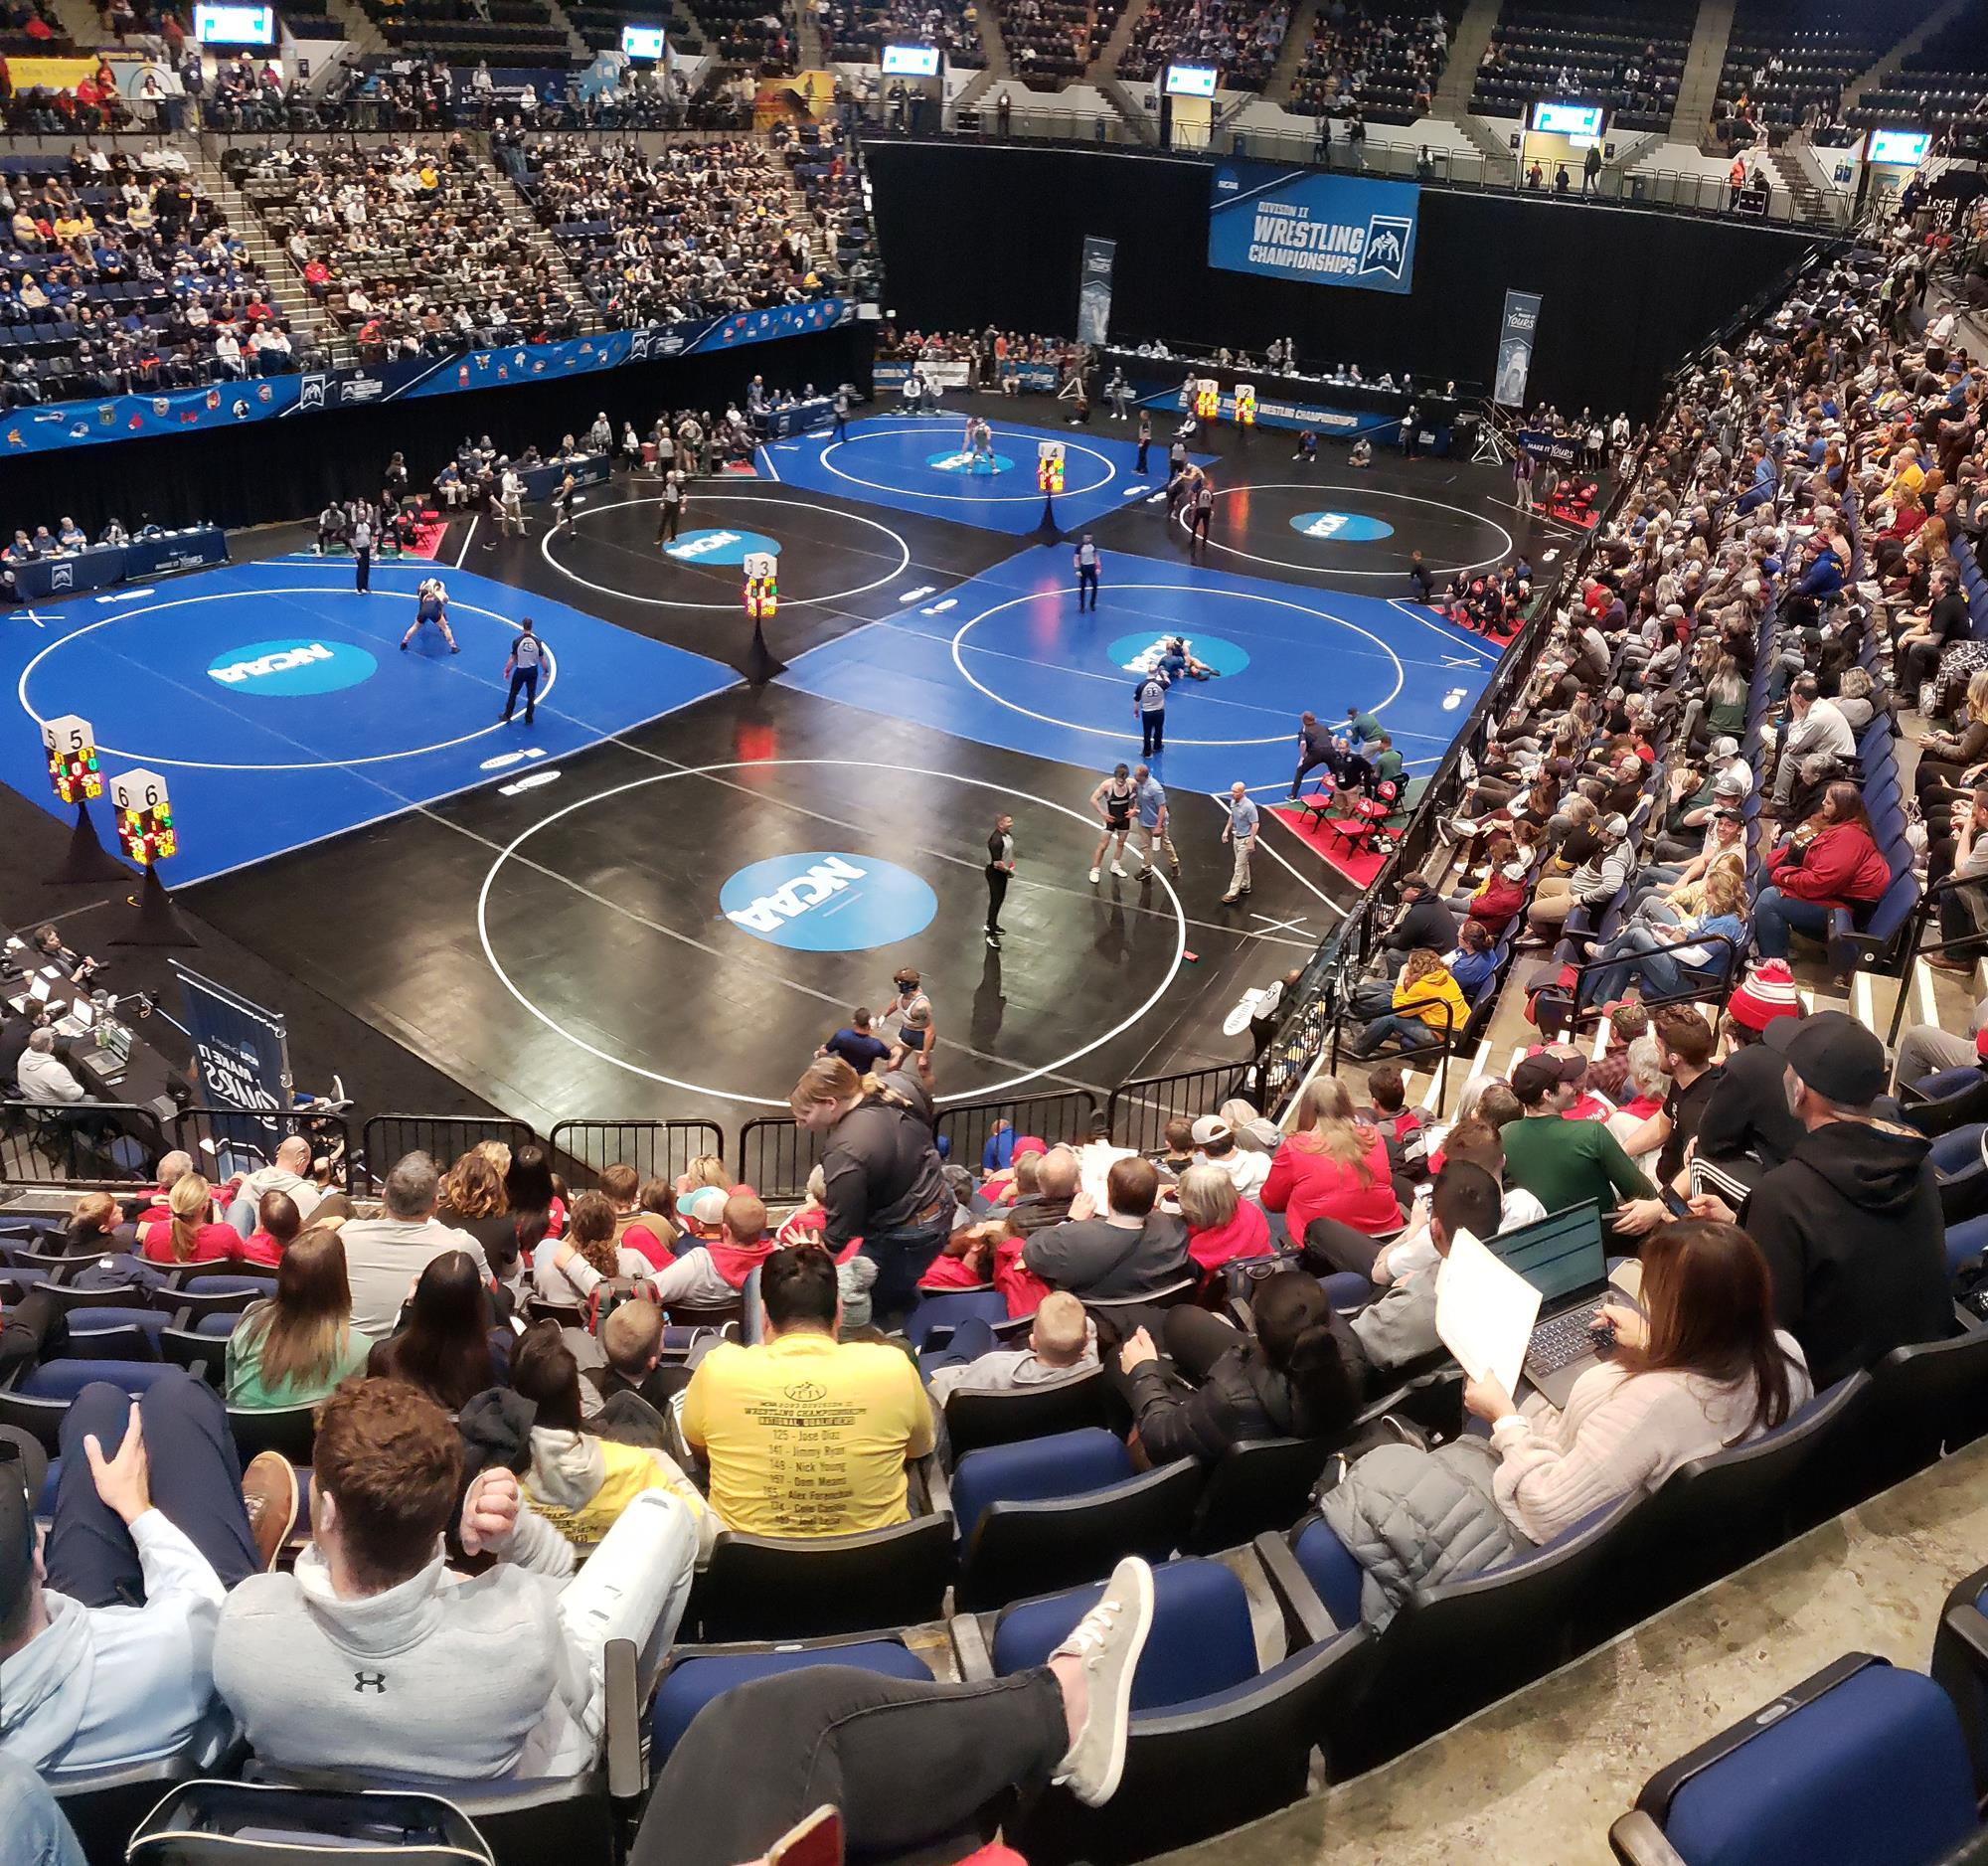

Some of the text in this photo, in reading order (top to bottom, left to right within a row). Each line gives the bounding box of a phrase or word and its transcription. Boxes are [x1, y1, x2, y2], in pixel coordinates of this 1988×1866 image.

[1257, 202, 1309, 219] DIVISION II
[1253, 216, 1365, 254] WRESTLING
[1248, 245, 1358, 275] CHAMPIONSHIPS
[1507, 313, 1535, 329] YOURS
[1243, 388, 1251, 398] 2
[1050, 447, 1059, 459] 4
[1527, 443, 1544, 452] MAKE
[1550, 443, 1574, 459] YOURS
[666, 531, 743, 558] NCAA
[760, 561, 769, 577] 3
[207, 643, 334, 683] NCAA
[48, 729, 57, 750] 5
[70, 729, 83, 751] 5
[79, 748, 95, 763] 87
[72, 763, 83, 775] 0
[87, 758, 98, 770] 0
[118, 786, 129, 807] 6
[145, 784, 158, 806] 6
[725, 856, 868, 933] NCAA
[745, 1408, 794, 1417] WRESTLING
[772, 1429, 788, 1441] 125
[798, 1431, 819, 1441] Jose
[821, 1430, 840, 1441] Diaz
[795, 1461, 816, 1472] Nick
